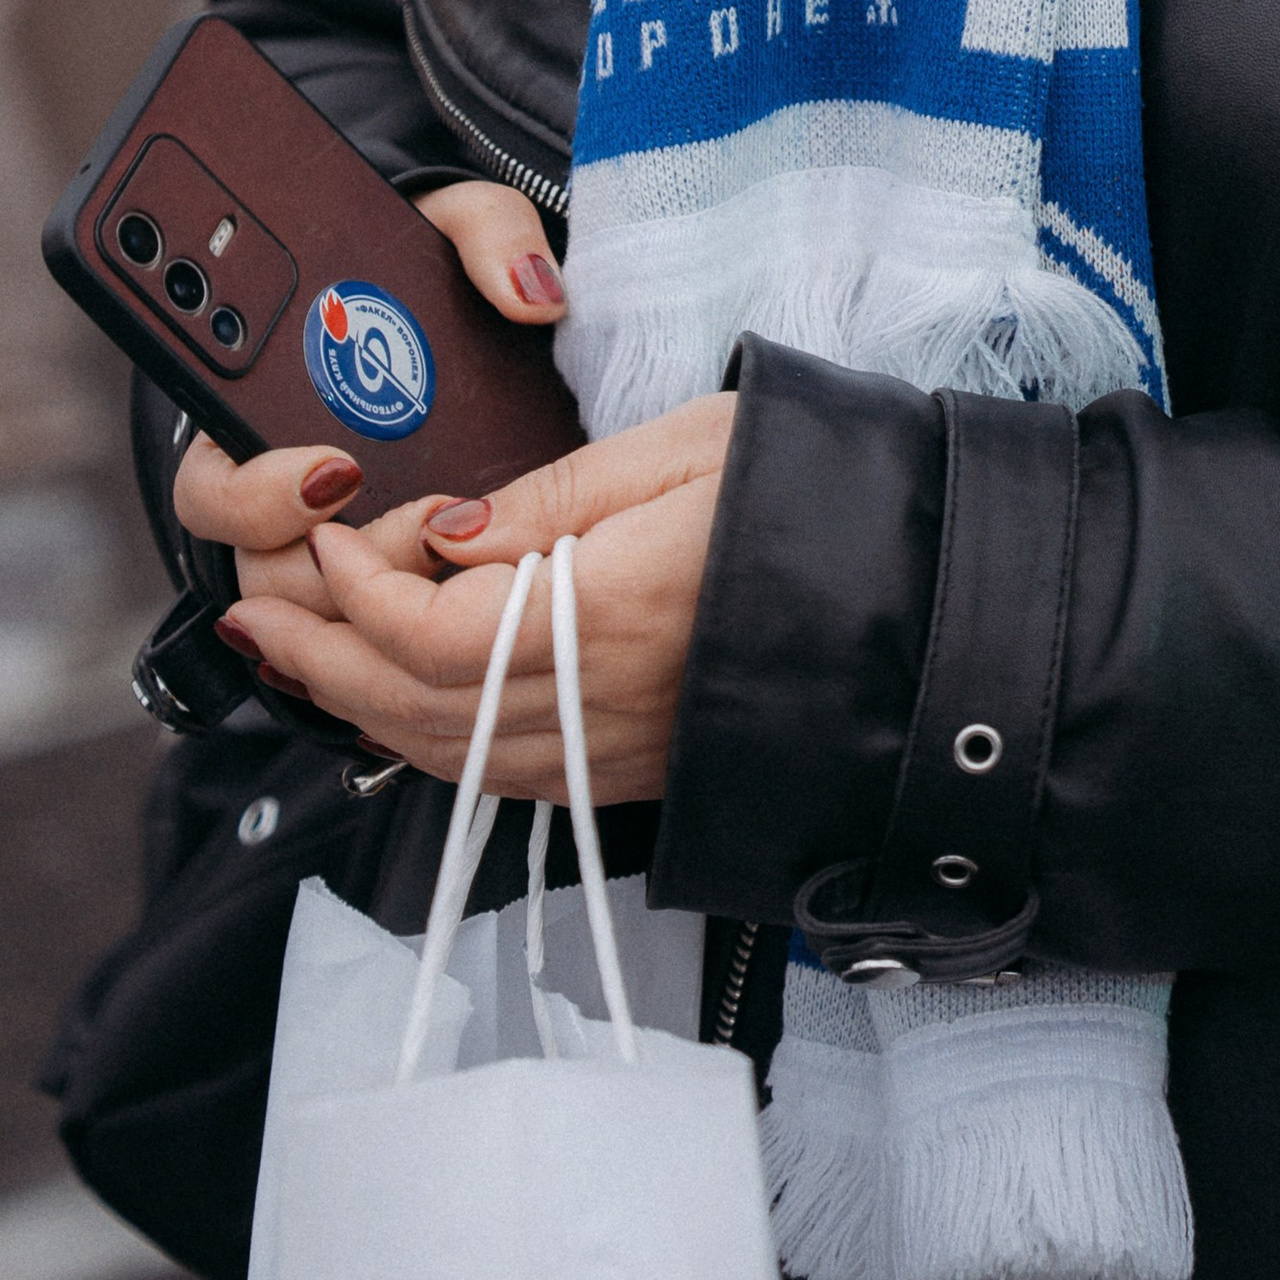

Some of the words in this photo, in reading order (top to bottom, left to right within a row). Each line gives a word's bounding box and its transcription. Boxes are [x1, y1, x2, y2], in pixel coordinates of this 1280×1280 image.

[328, 348, 344, 381] КЛУБ
[396, 326, 419, 383] ВОРОНЕЖ
[339, 381, 404, 415] ФУТБОЛЬНЫЙ
